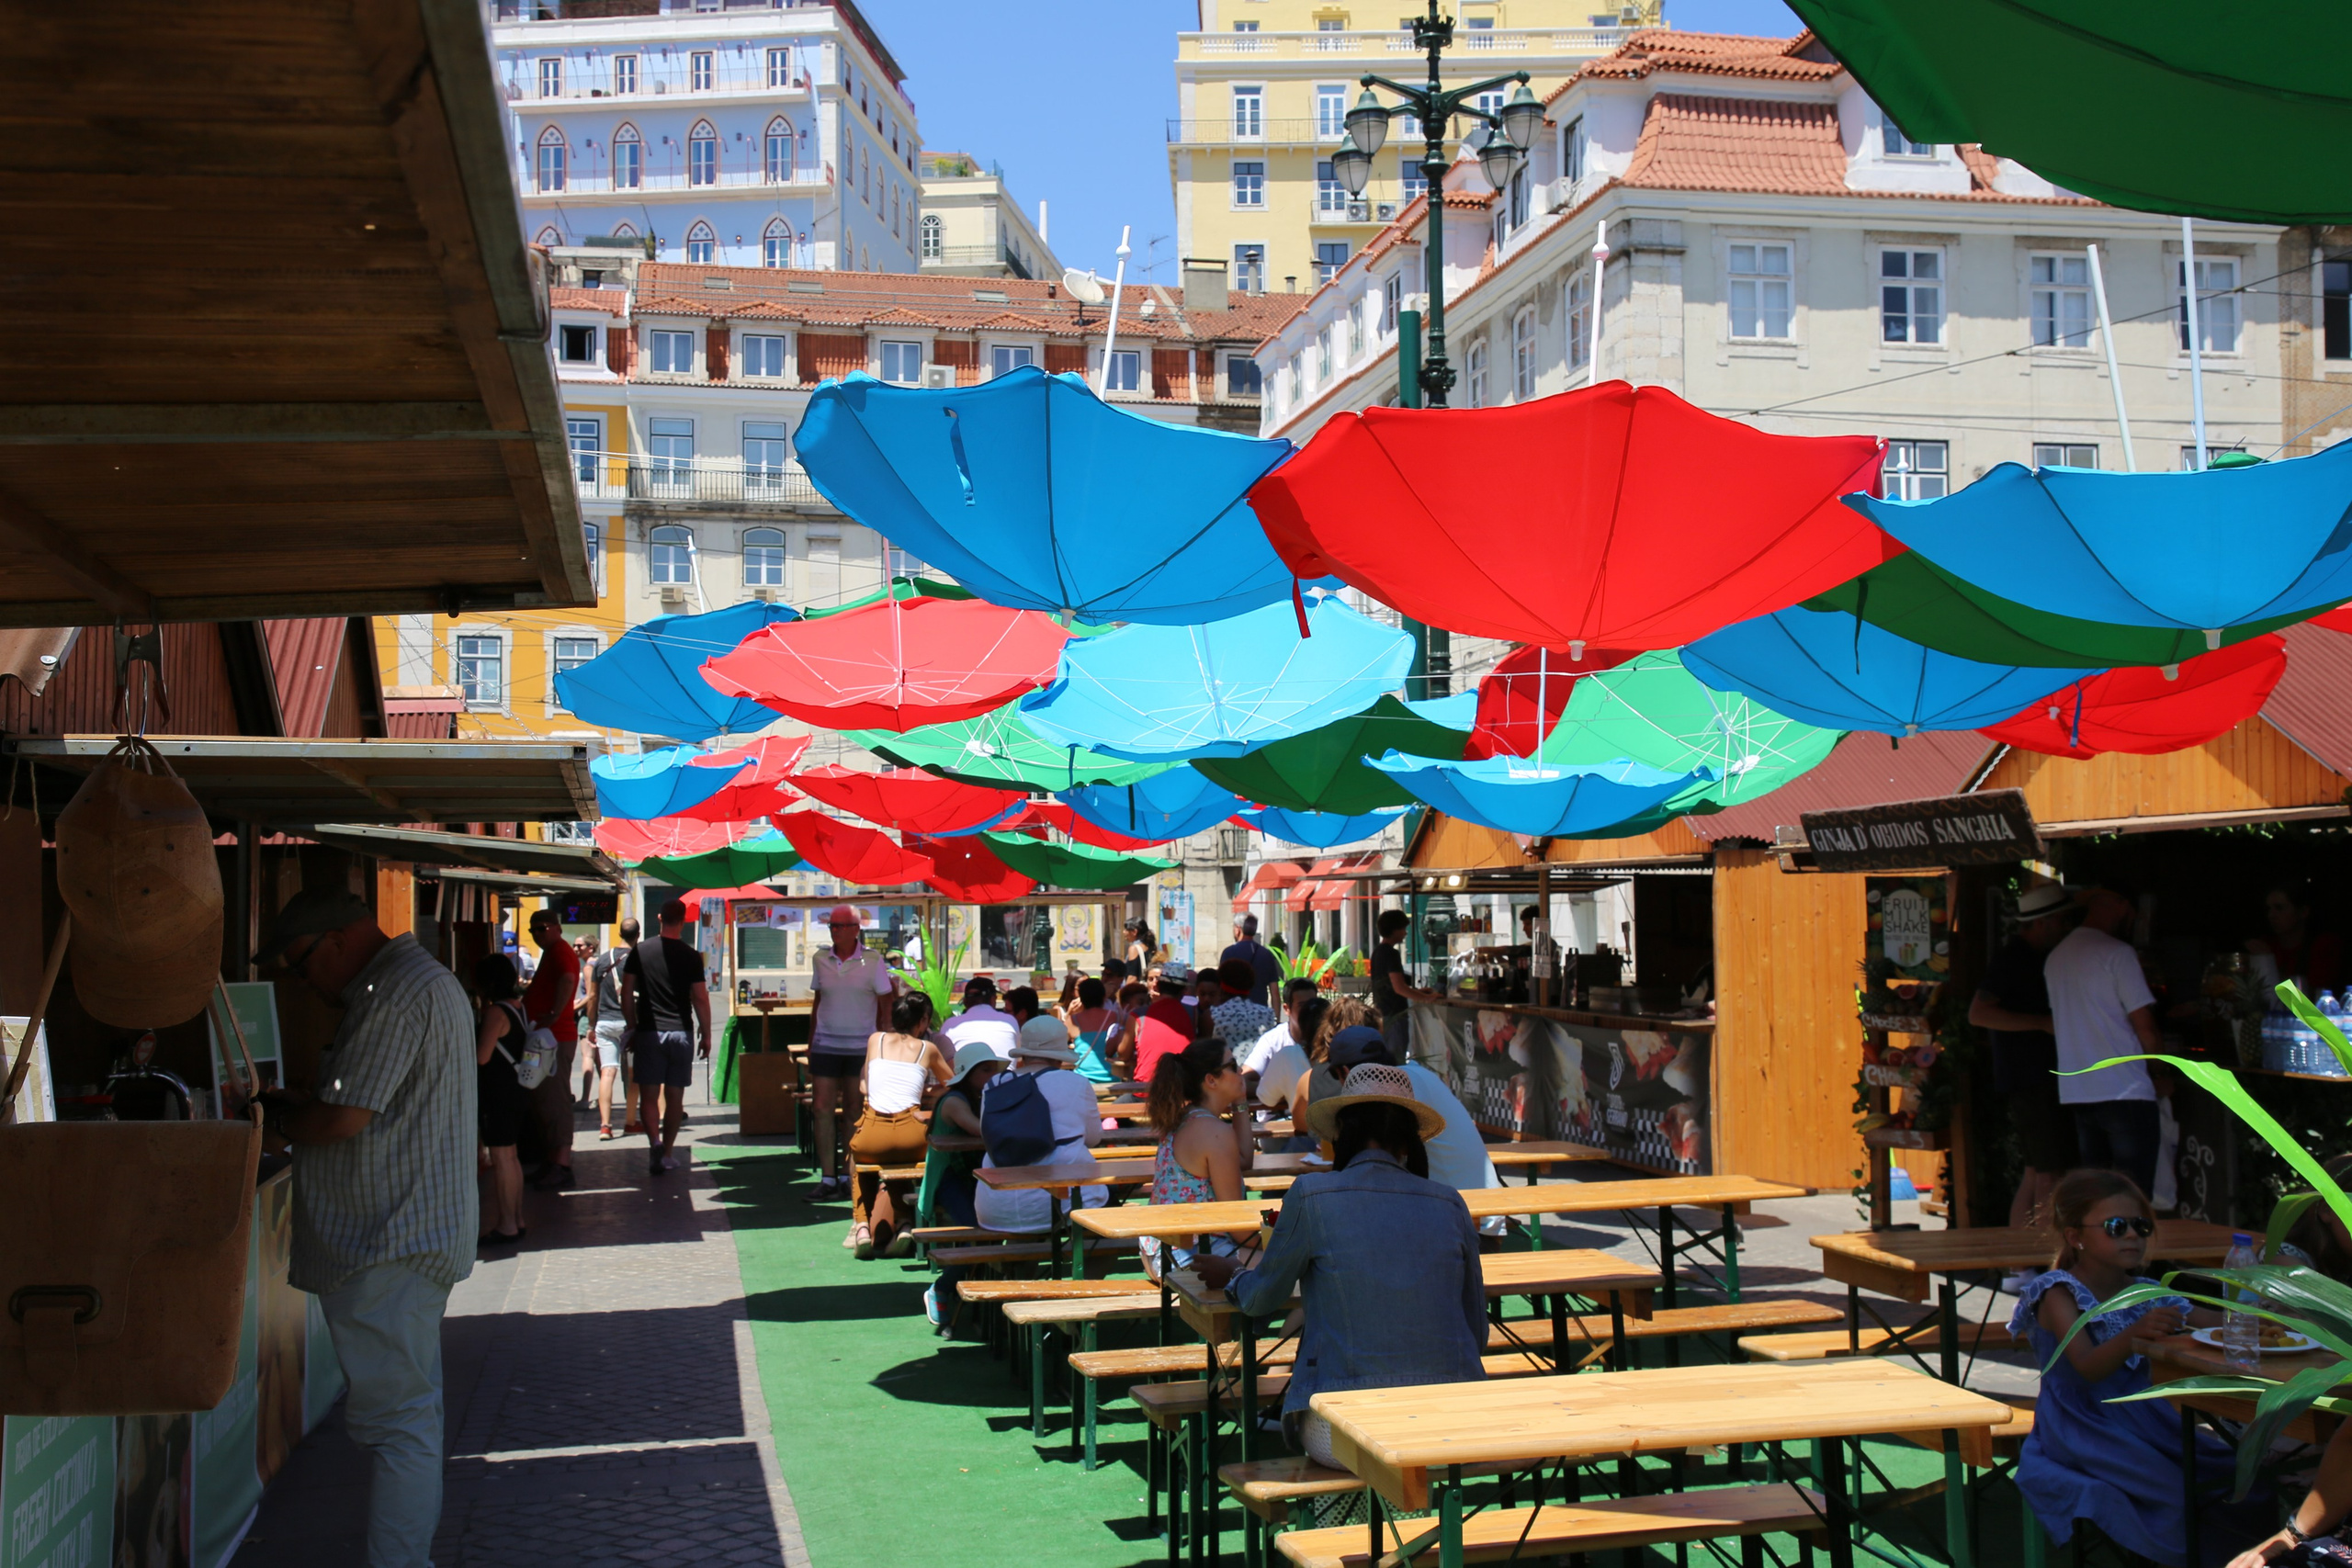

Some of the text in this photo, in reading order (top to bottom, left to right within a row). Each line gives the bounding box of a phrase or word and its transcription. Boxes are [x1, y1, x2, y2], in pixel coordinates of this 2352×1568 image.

[1811, 828, 1857, 852] GINJA
[1869, 820, 1930, 849] OBIDOS
[1932, 814, 2017, 844] SANGRIA
[1883, 897, 1927, 910] FRUIT
[1883, 909, 1928, 922] MILK
[1884, 920, 1928, 934] SHAKE
[11, 1476, 51, 1568] FRESH
